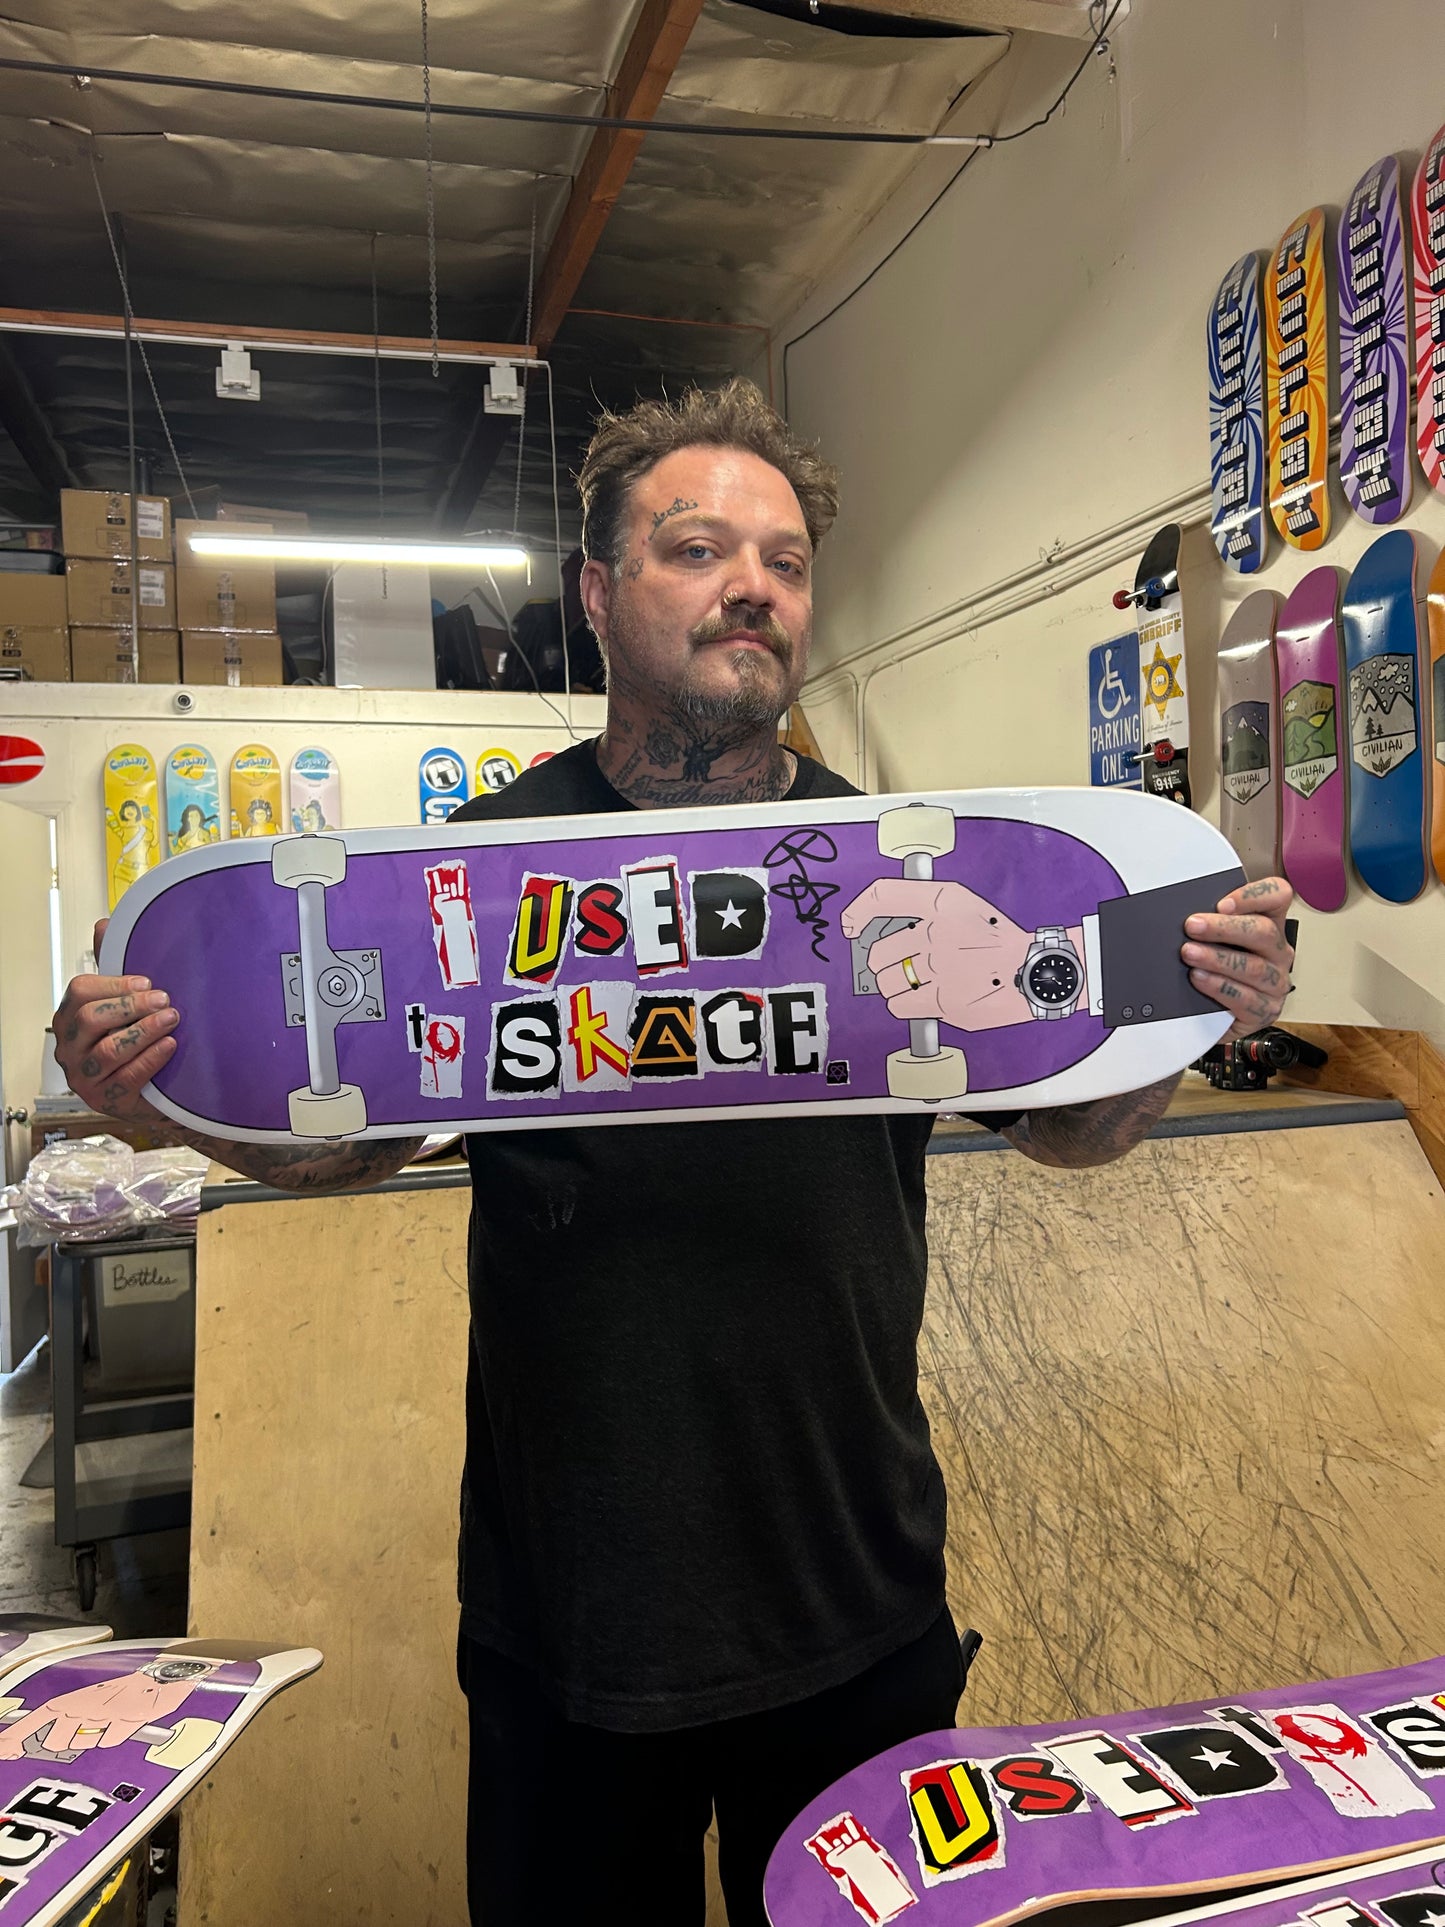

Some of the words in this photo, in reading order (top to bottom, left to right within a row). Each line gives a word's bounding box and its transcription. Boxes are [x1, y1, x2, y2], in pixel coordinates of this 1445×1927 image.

[1349, 173, 1398, 508] CIVILIAN
[1276, 223, 1319, 537] CIVILIAN
[1091, 714, 1140, 754] PARKING
[1362, 740, 1403, 757] CIVILIAN
[1156, 776, 1173, 791] 911
[1230, 773, 1260, 787] CIVILIAN
[1291, 763, 1326, 780] CIVILIAN
[508, 864, 767, 983] USED
[112, 1264, 178, 1291] Bottles
[911, 1728, 1279, 1874] USED
